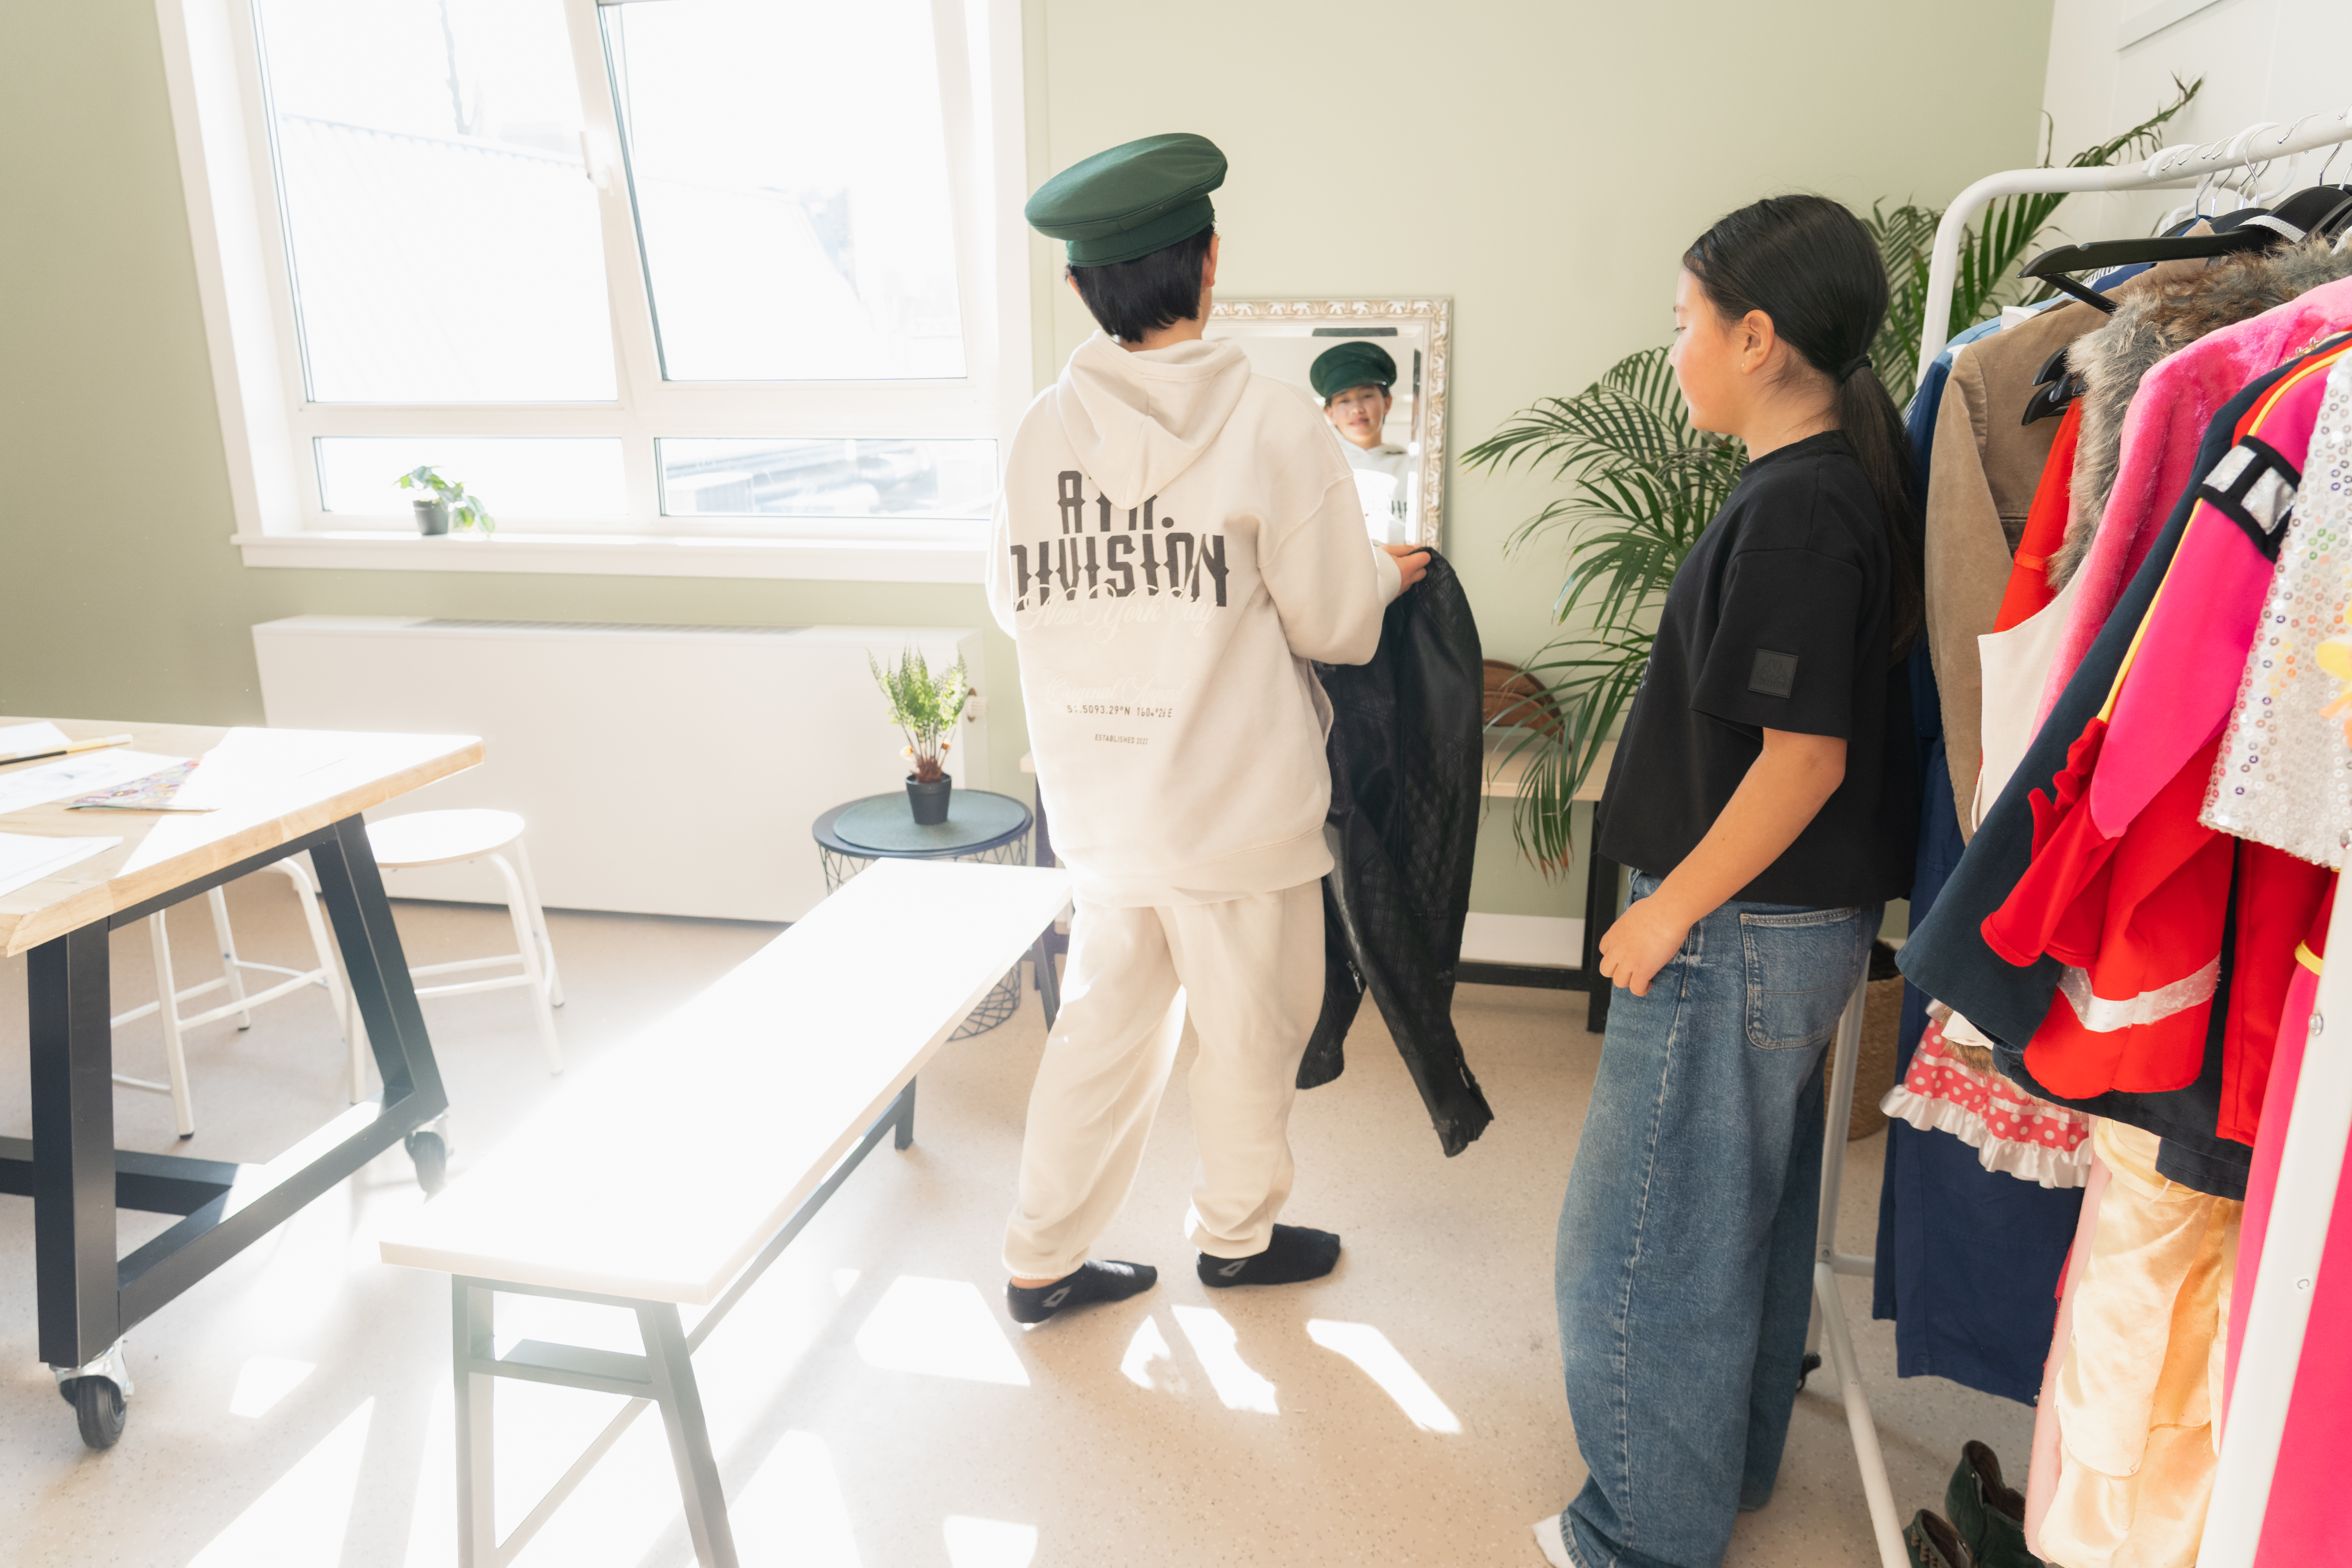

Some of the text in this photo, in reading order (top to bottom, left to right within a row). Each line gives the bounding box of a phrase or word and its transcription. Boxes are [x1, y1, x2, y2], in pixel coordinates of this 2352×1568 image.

[1014, 583, 1217, 644] New York City
[1042, 669, 1125, 709] Original
[1095, 734, 1135, 744] ESTABLISHED
